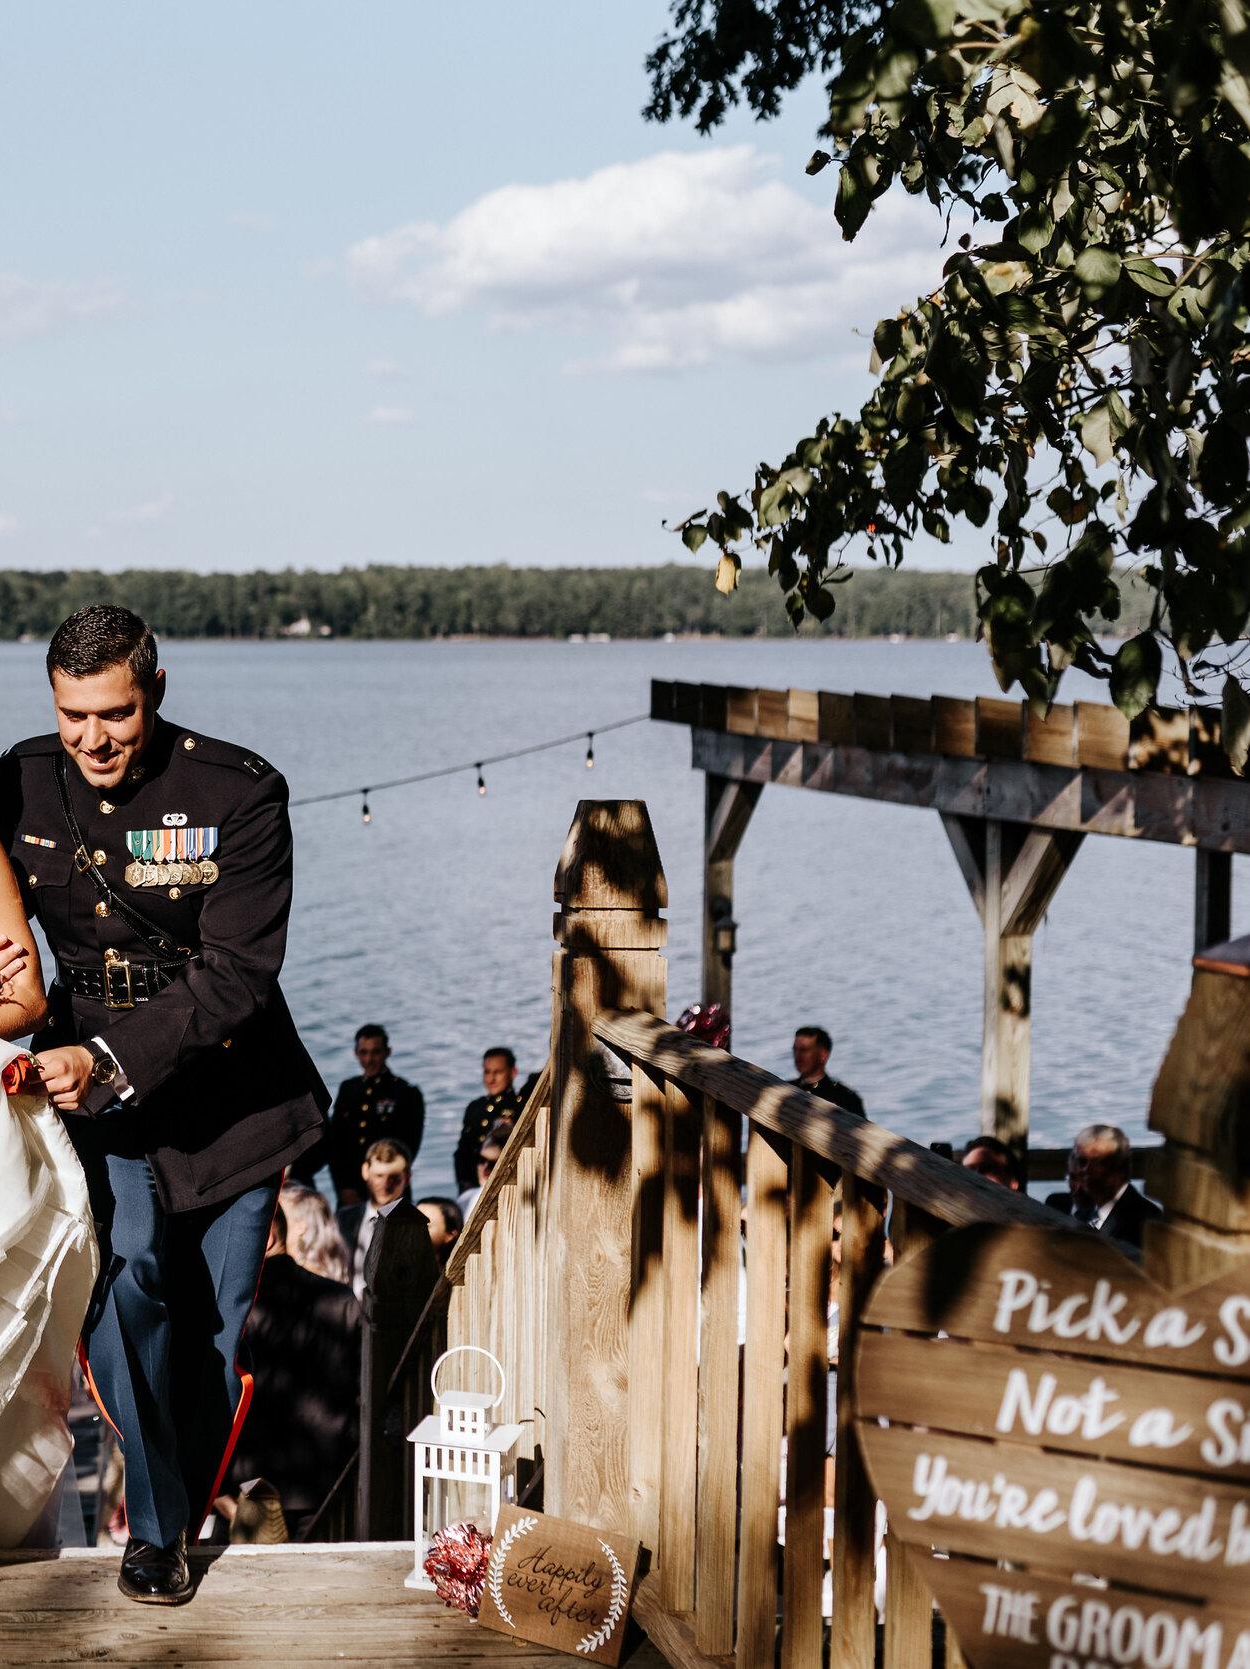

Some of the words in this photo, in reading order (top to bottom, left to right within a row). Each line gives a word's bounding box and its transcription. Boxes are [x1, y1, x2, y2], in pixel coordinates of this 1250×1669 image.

[993, 1268, 1140, 1344] Pick
[1144, 1307, 1206, 1348] a
[995, 1367, 1126, 1440] Not
[1128, 1407, 1193, 1448] a
[907, 1452, 1065, 1531] You're
[1068, 1474, 1223, 1561] loved
[507, 1570, 549, 1596] ever
[518, 1546, 605, 1599] Happily
[537, 1587, 602, 1626] after
[979, 1583, 1041, 1645] THE
[1045, 1593, 1224, 1669] GROOM
